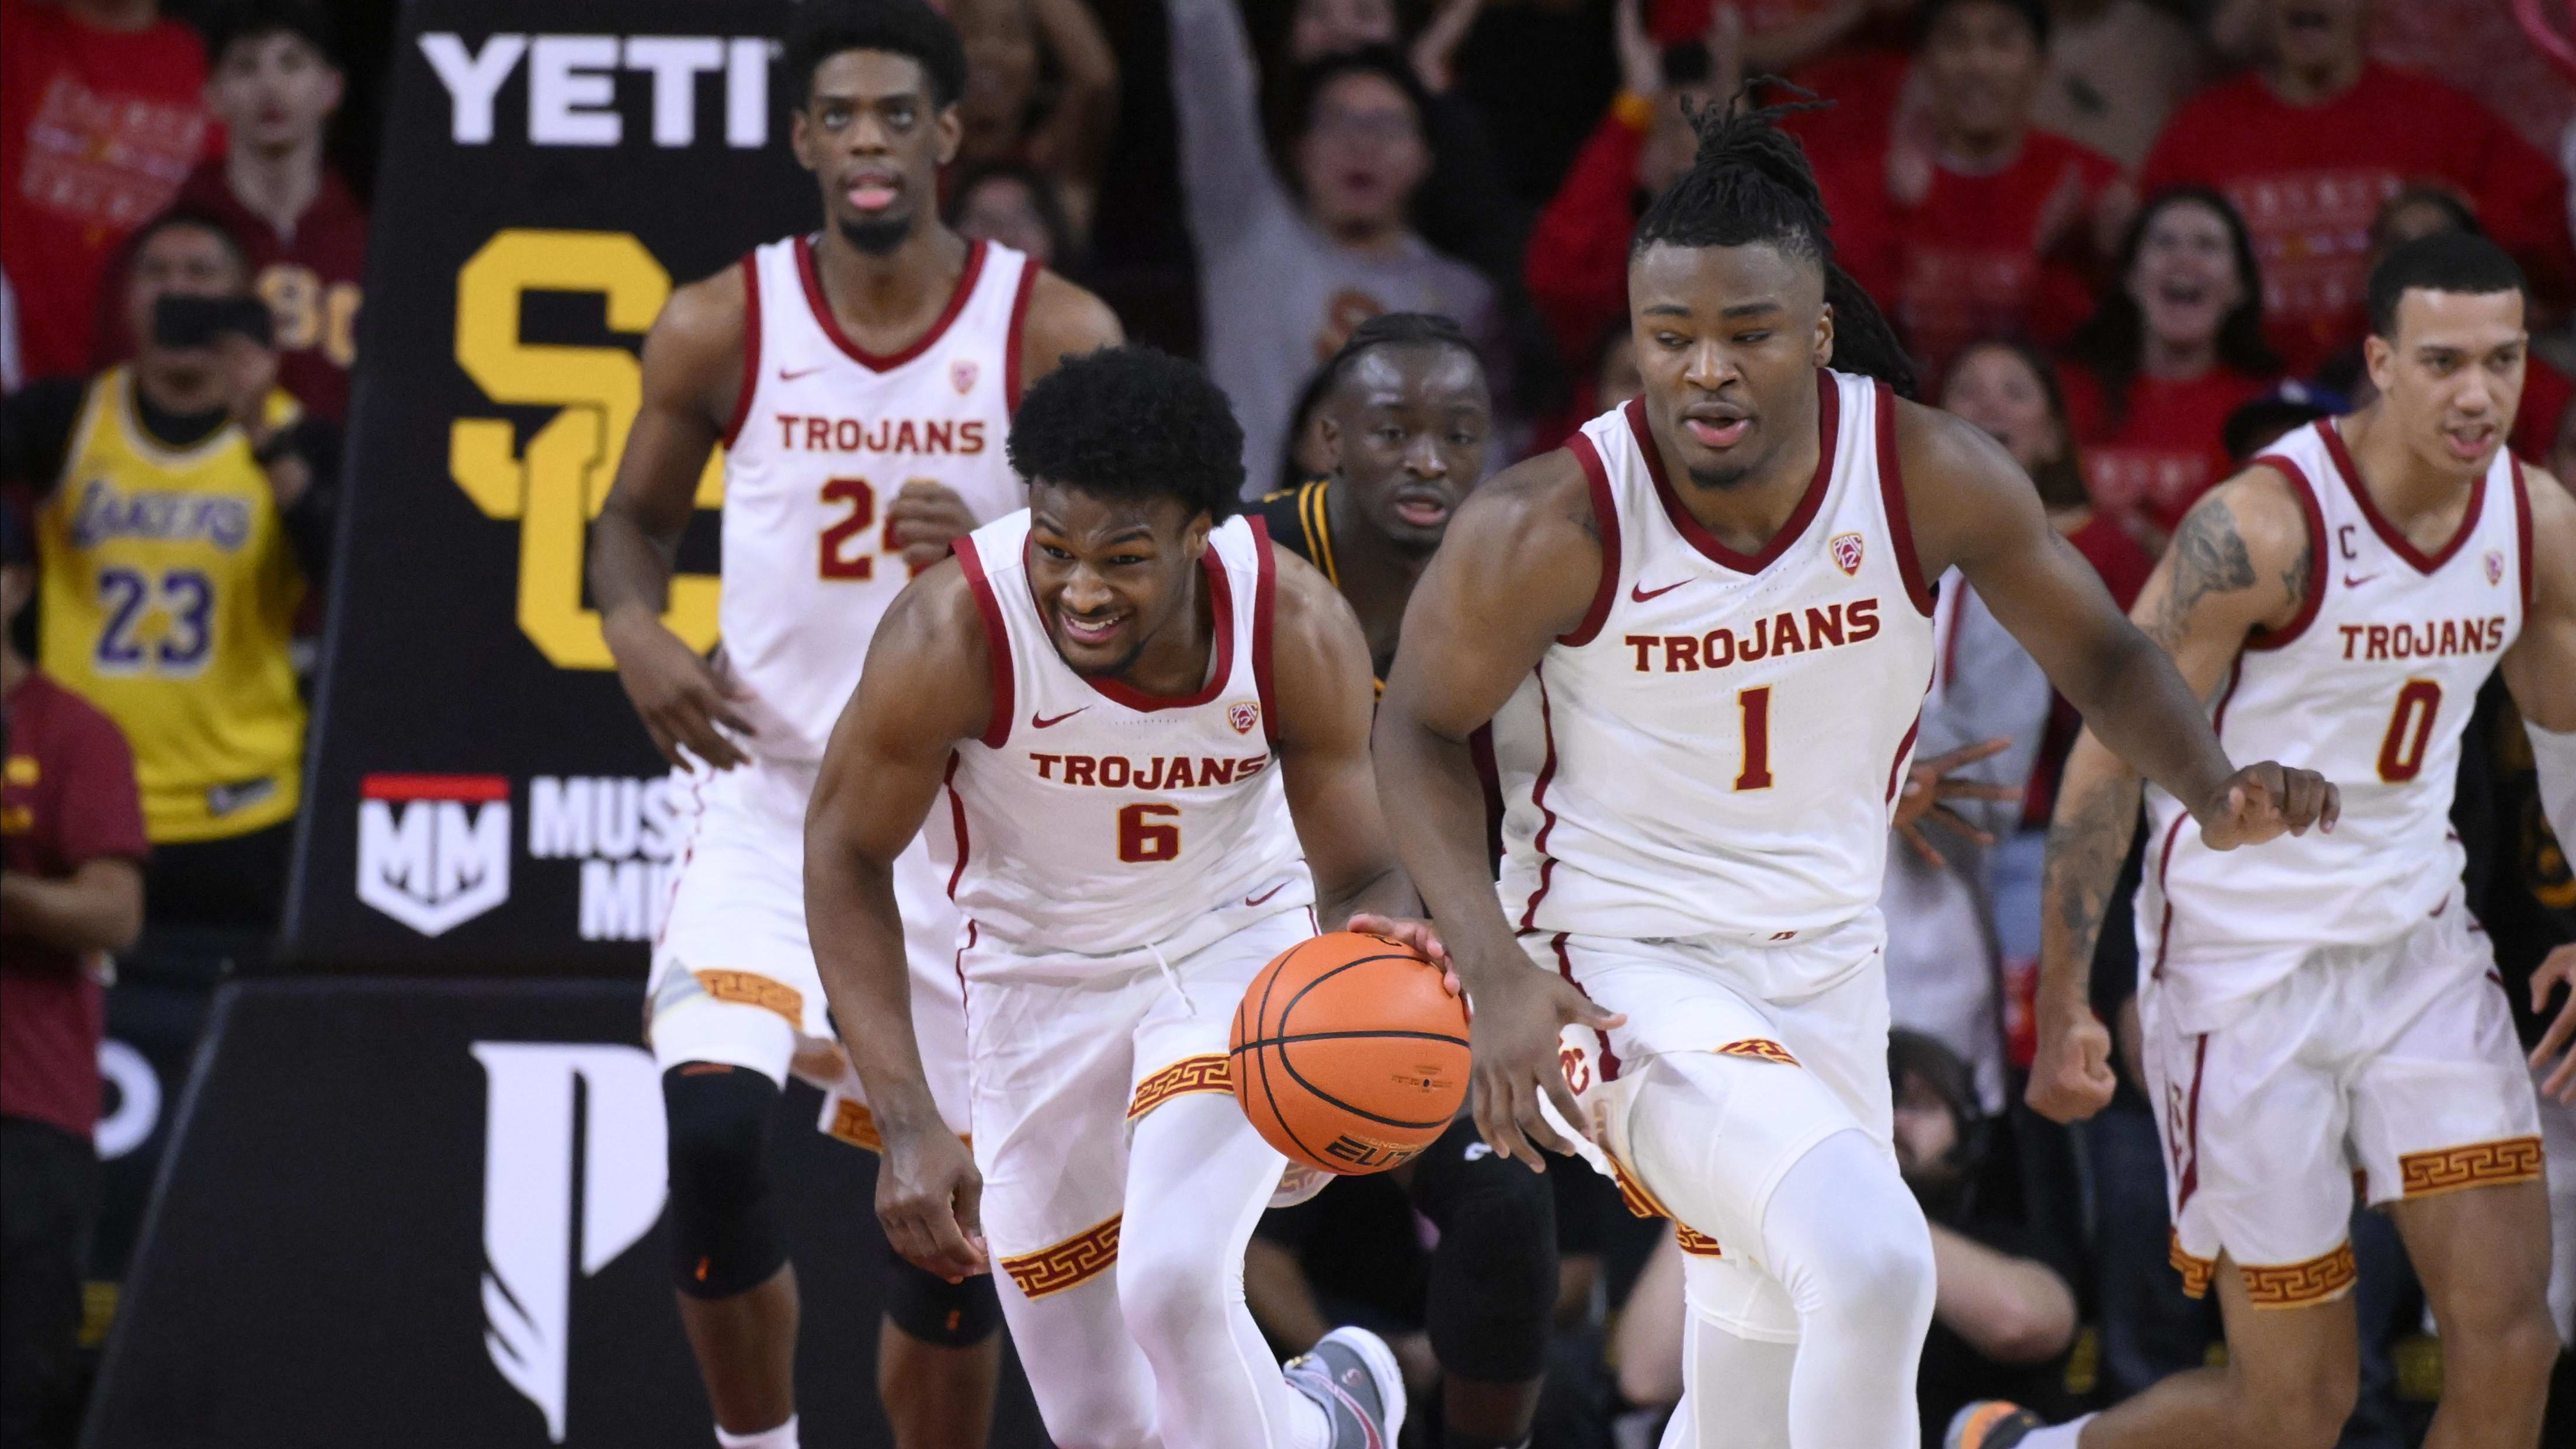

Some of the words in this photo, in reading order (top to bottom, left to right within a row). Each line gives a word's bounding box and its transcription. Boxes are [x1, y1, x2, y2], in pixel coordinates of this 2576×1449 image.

[418, 32, 770, 150] YETI
[776, 414, 984, 455] TROJANS
[1841, 551, 1858, 570] 12
[2338, 525, 2356, 560] C
[95, 568, 217, 673] 23
[1624, 597, 1881, 674] TROJANS
[2338, 616, 2505, 660] TROJANS
[1236, 716, 1251, 730] 12
[1733, 684, 1775, 793] 1
[2377, 678, 2442, 783] 0
[1029, 752, 1268, 791] TROJANS
[528, 775, 676, 861] MUS
[1116, 803, 1181, 864] 6
[1324, 1135, 1416, 1167] ELIT
